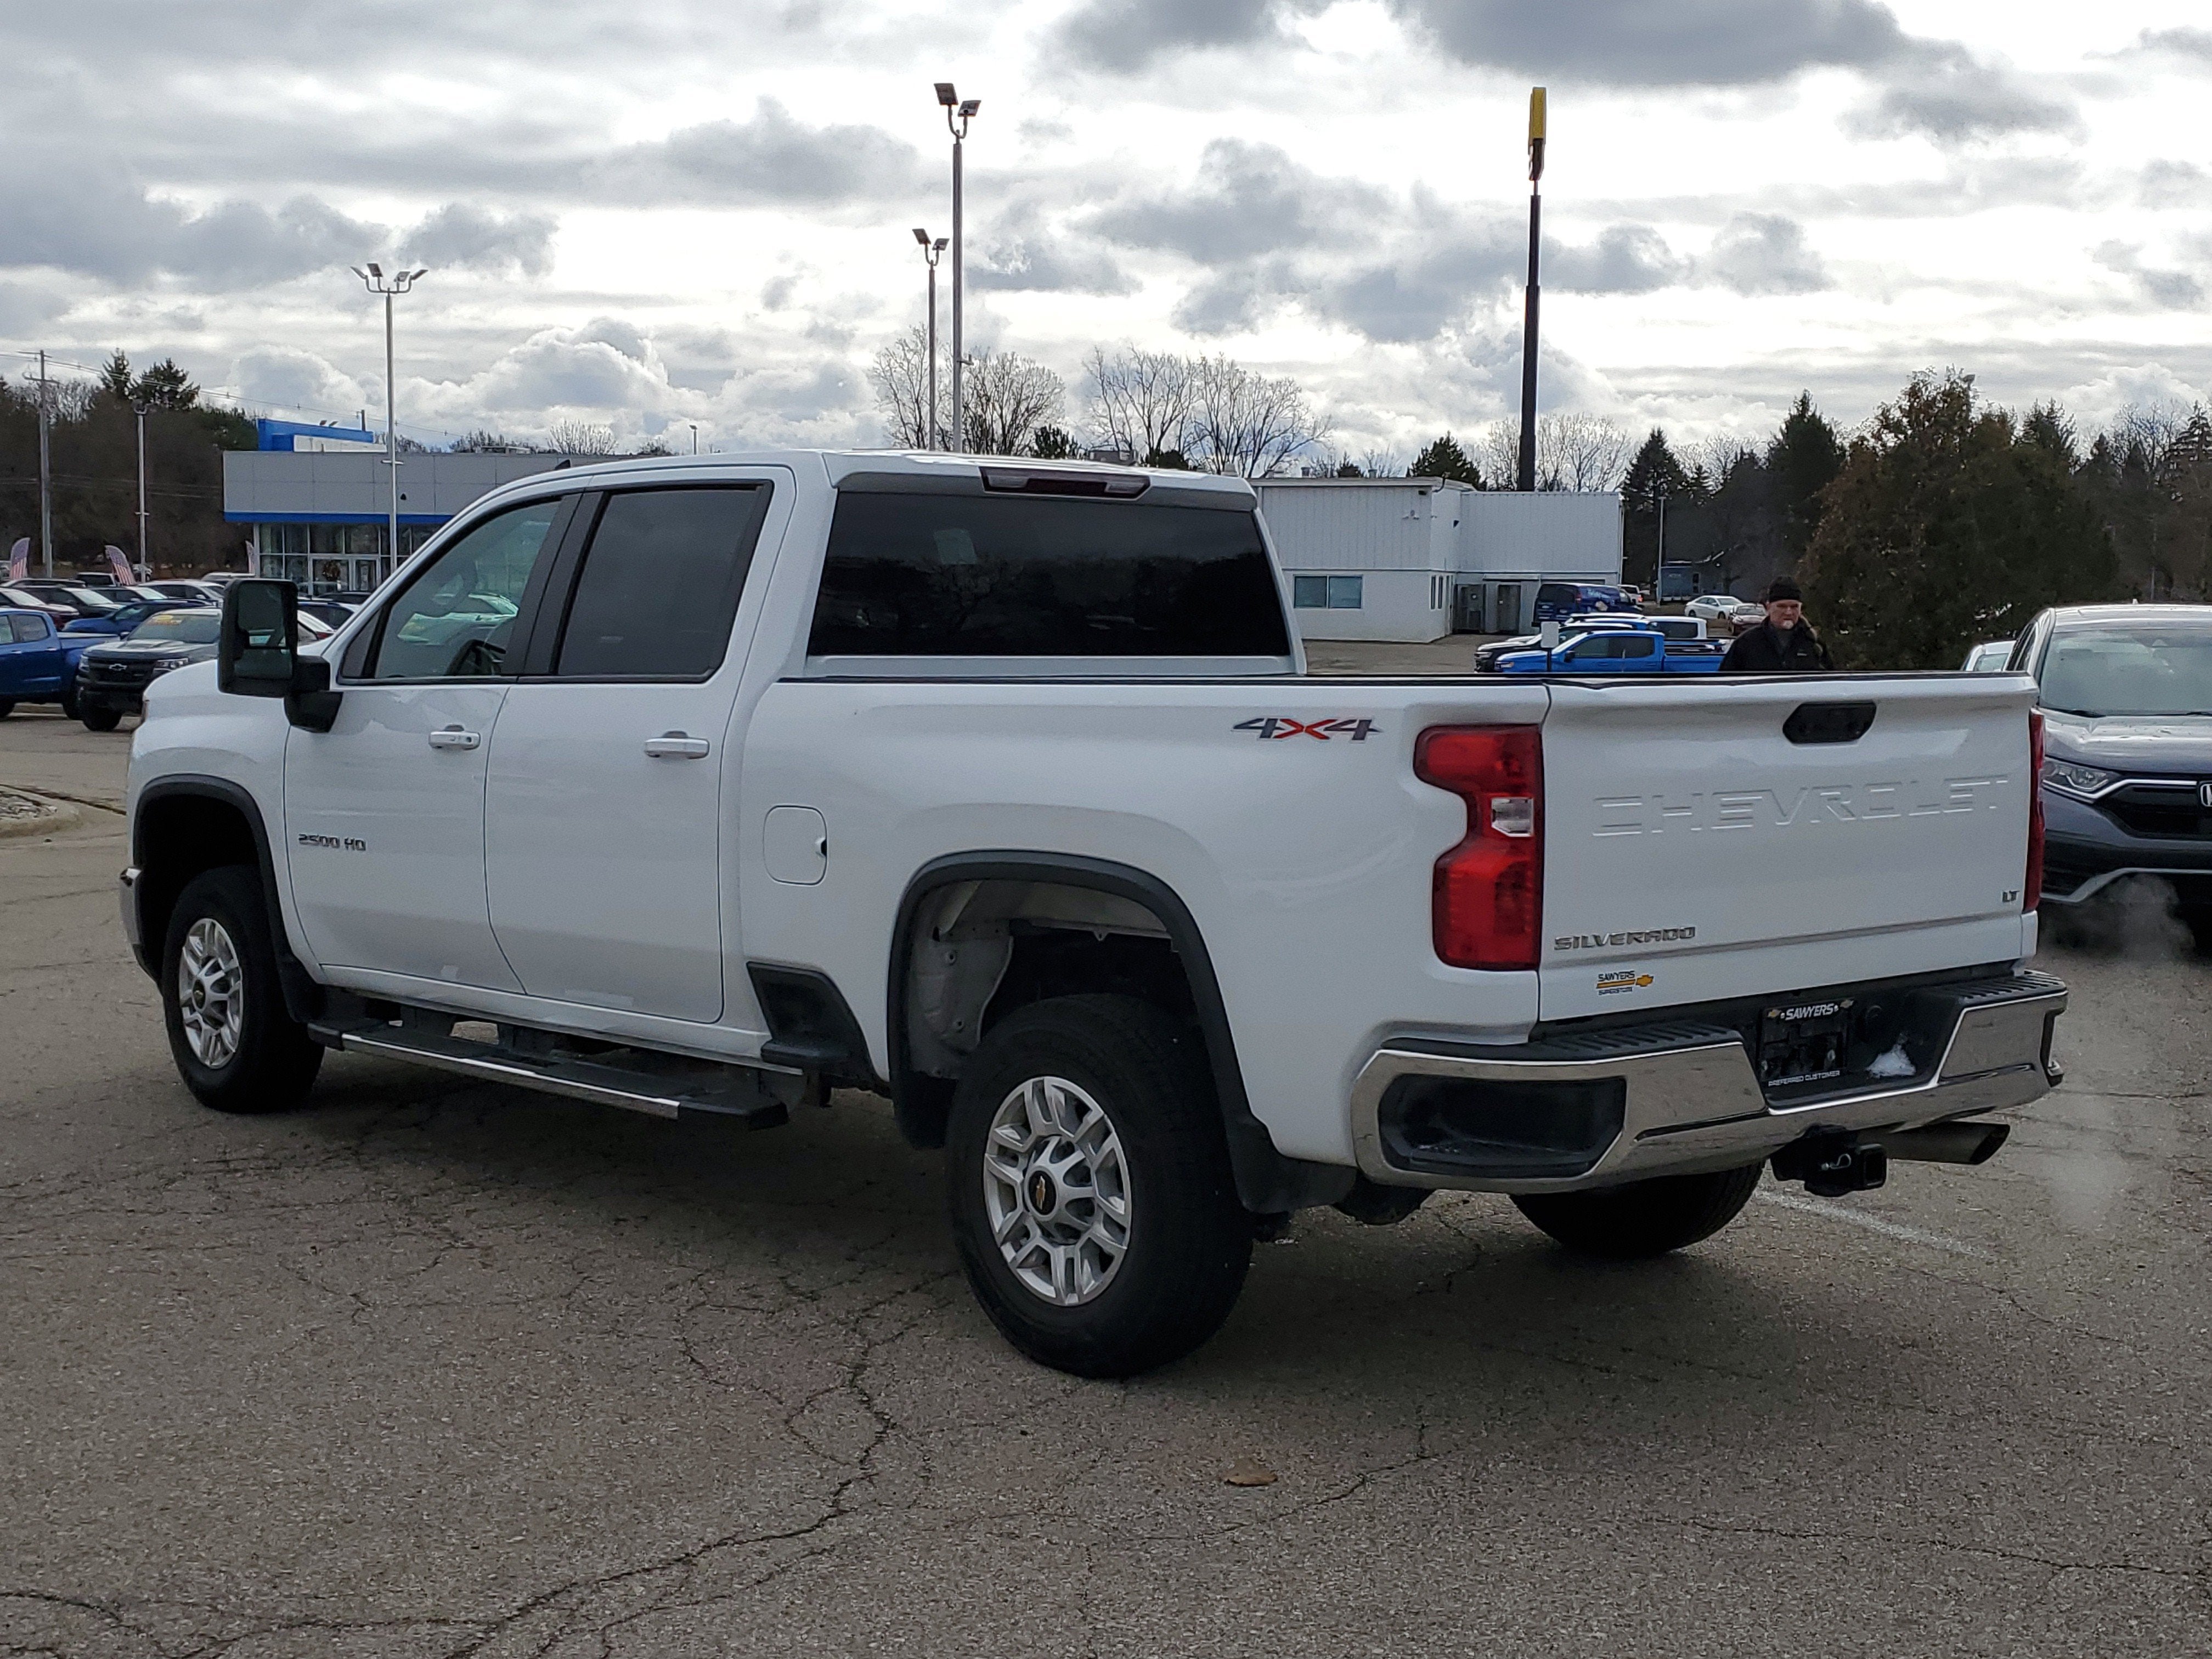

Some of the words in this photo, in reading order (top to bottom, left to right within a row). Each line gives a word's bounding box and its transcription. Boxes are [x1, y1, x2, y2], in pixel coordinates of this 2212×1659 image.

[1593, 775, 2008, 836] CHEVROLET
[298, 833, 340, 848] 2500
[344, 837, 366, 851] HD
[2002, 890, 2020, 903] LT
[1554, 926, 1696, 950] SILVERADO
[1598, 970, 1635, 981] SAWYERS
[1785, 1003, 1835, 1021] SAWYERS
[1768, 1076, 1804, 1087] PREFERRED
[1804, 1070, 1841, 1081] CUSTOMER
